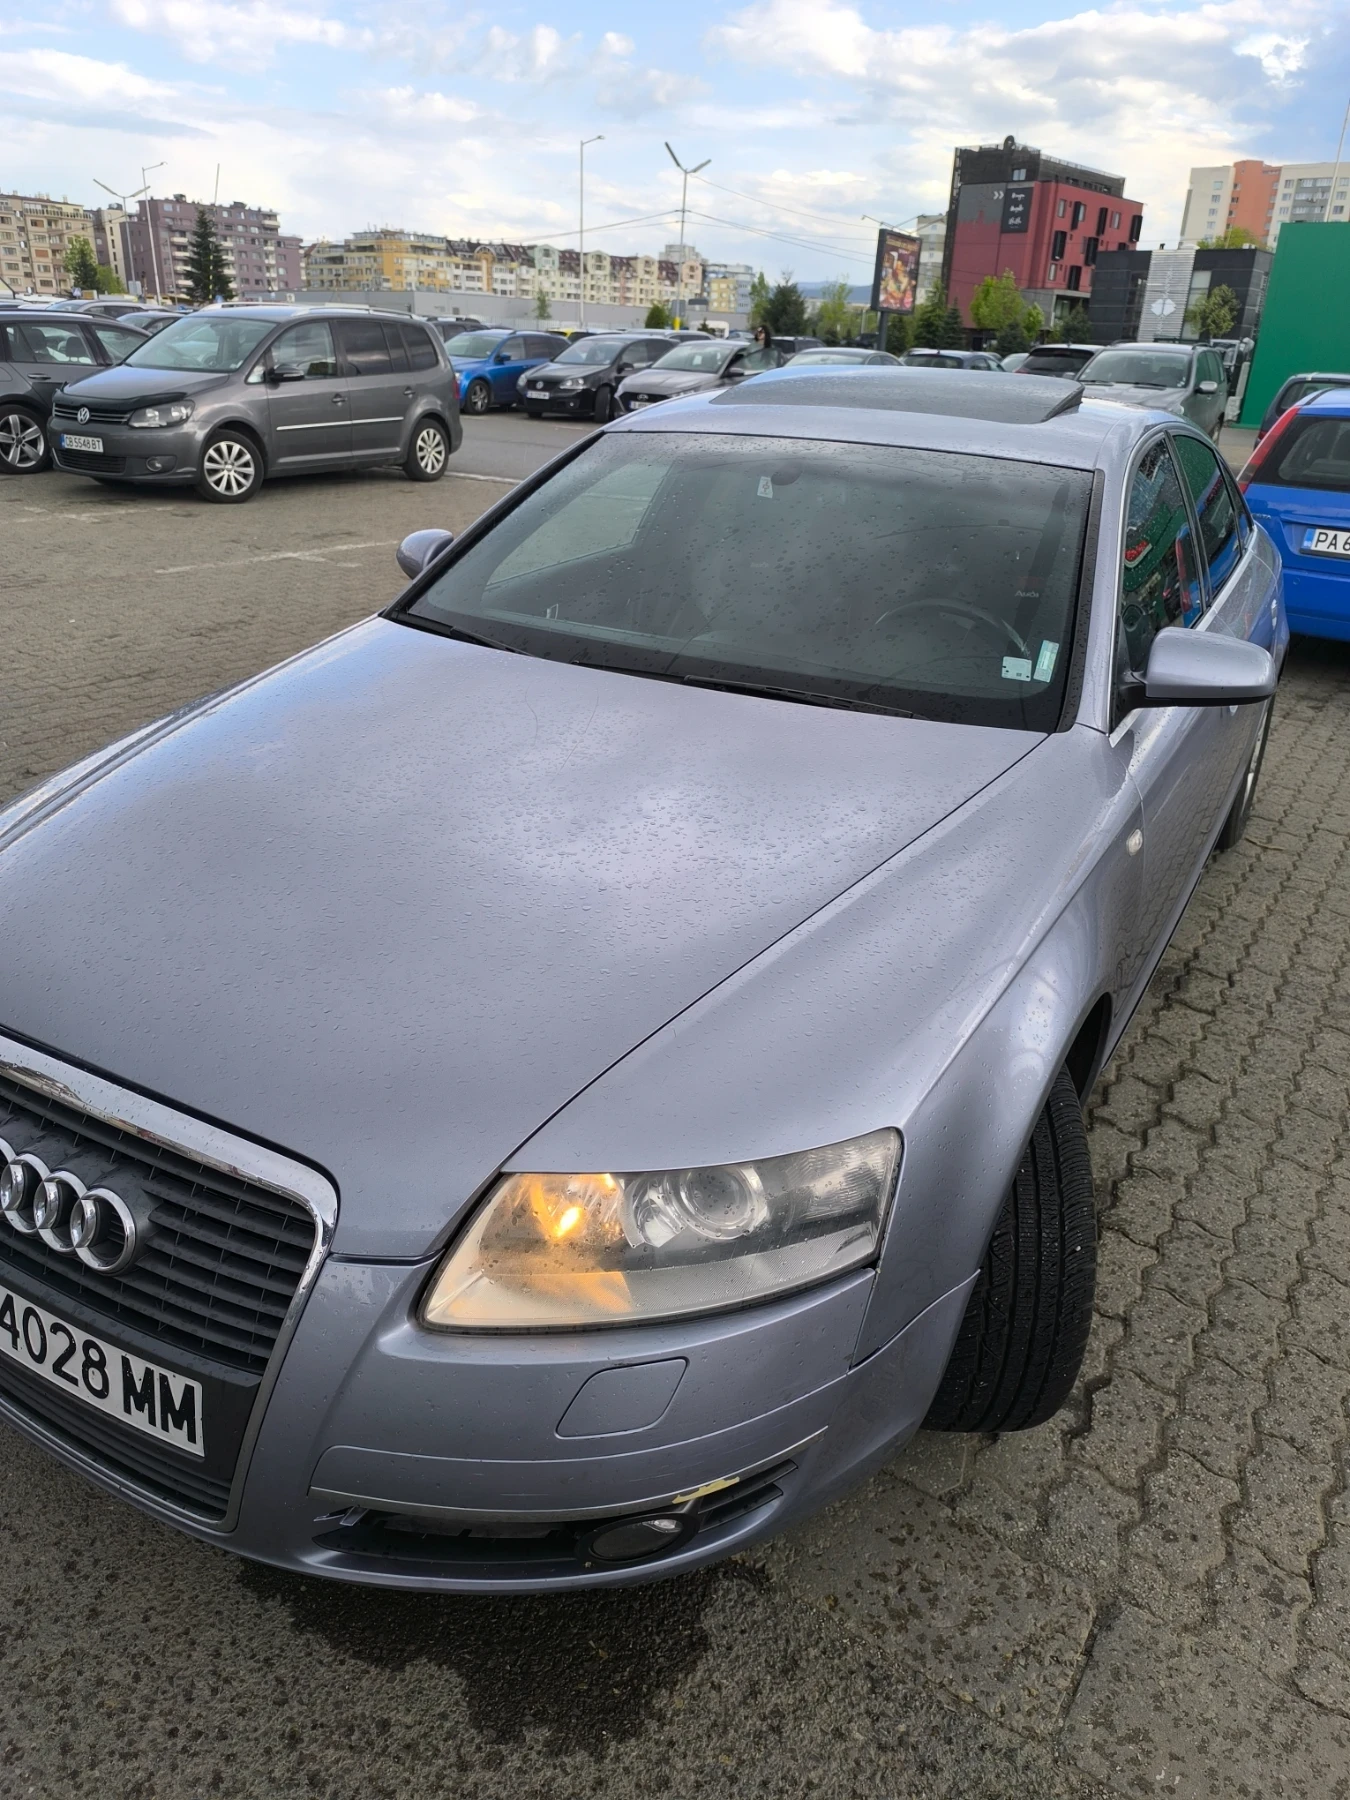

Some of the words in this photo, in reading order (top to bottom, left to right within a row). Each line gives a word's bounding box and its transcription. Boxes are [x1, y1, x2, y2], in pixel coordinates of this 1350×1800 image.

[74, 437, 91, 449] 5548
[91, 439, 101, 450] BT
[1315, 532, 1338, 551] PA
[0, 1293, 110, 1400] 4028
[121, 1354, 197, 1445] MM
